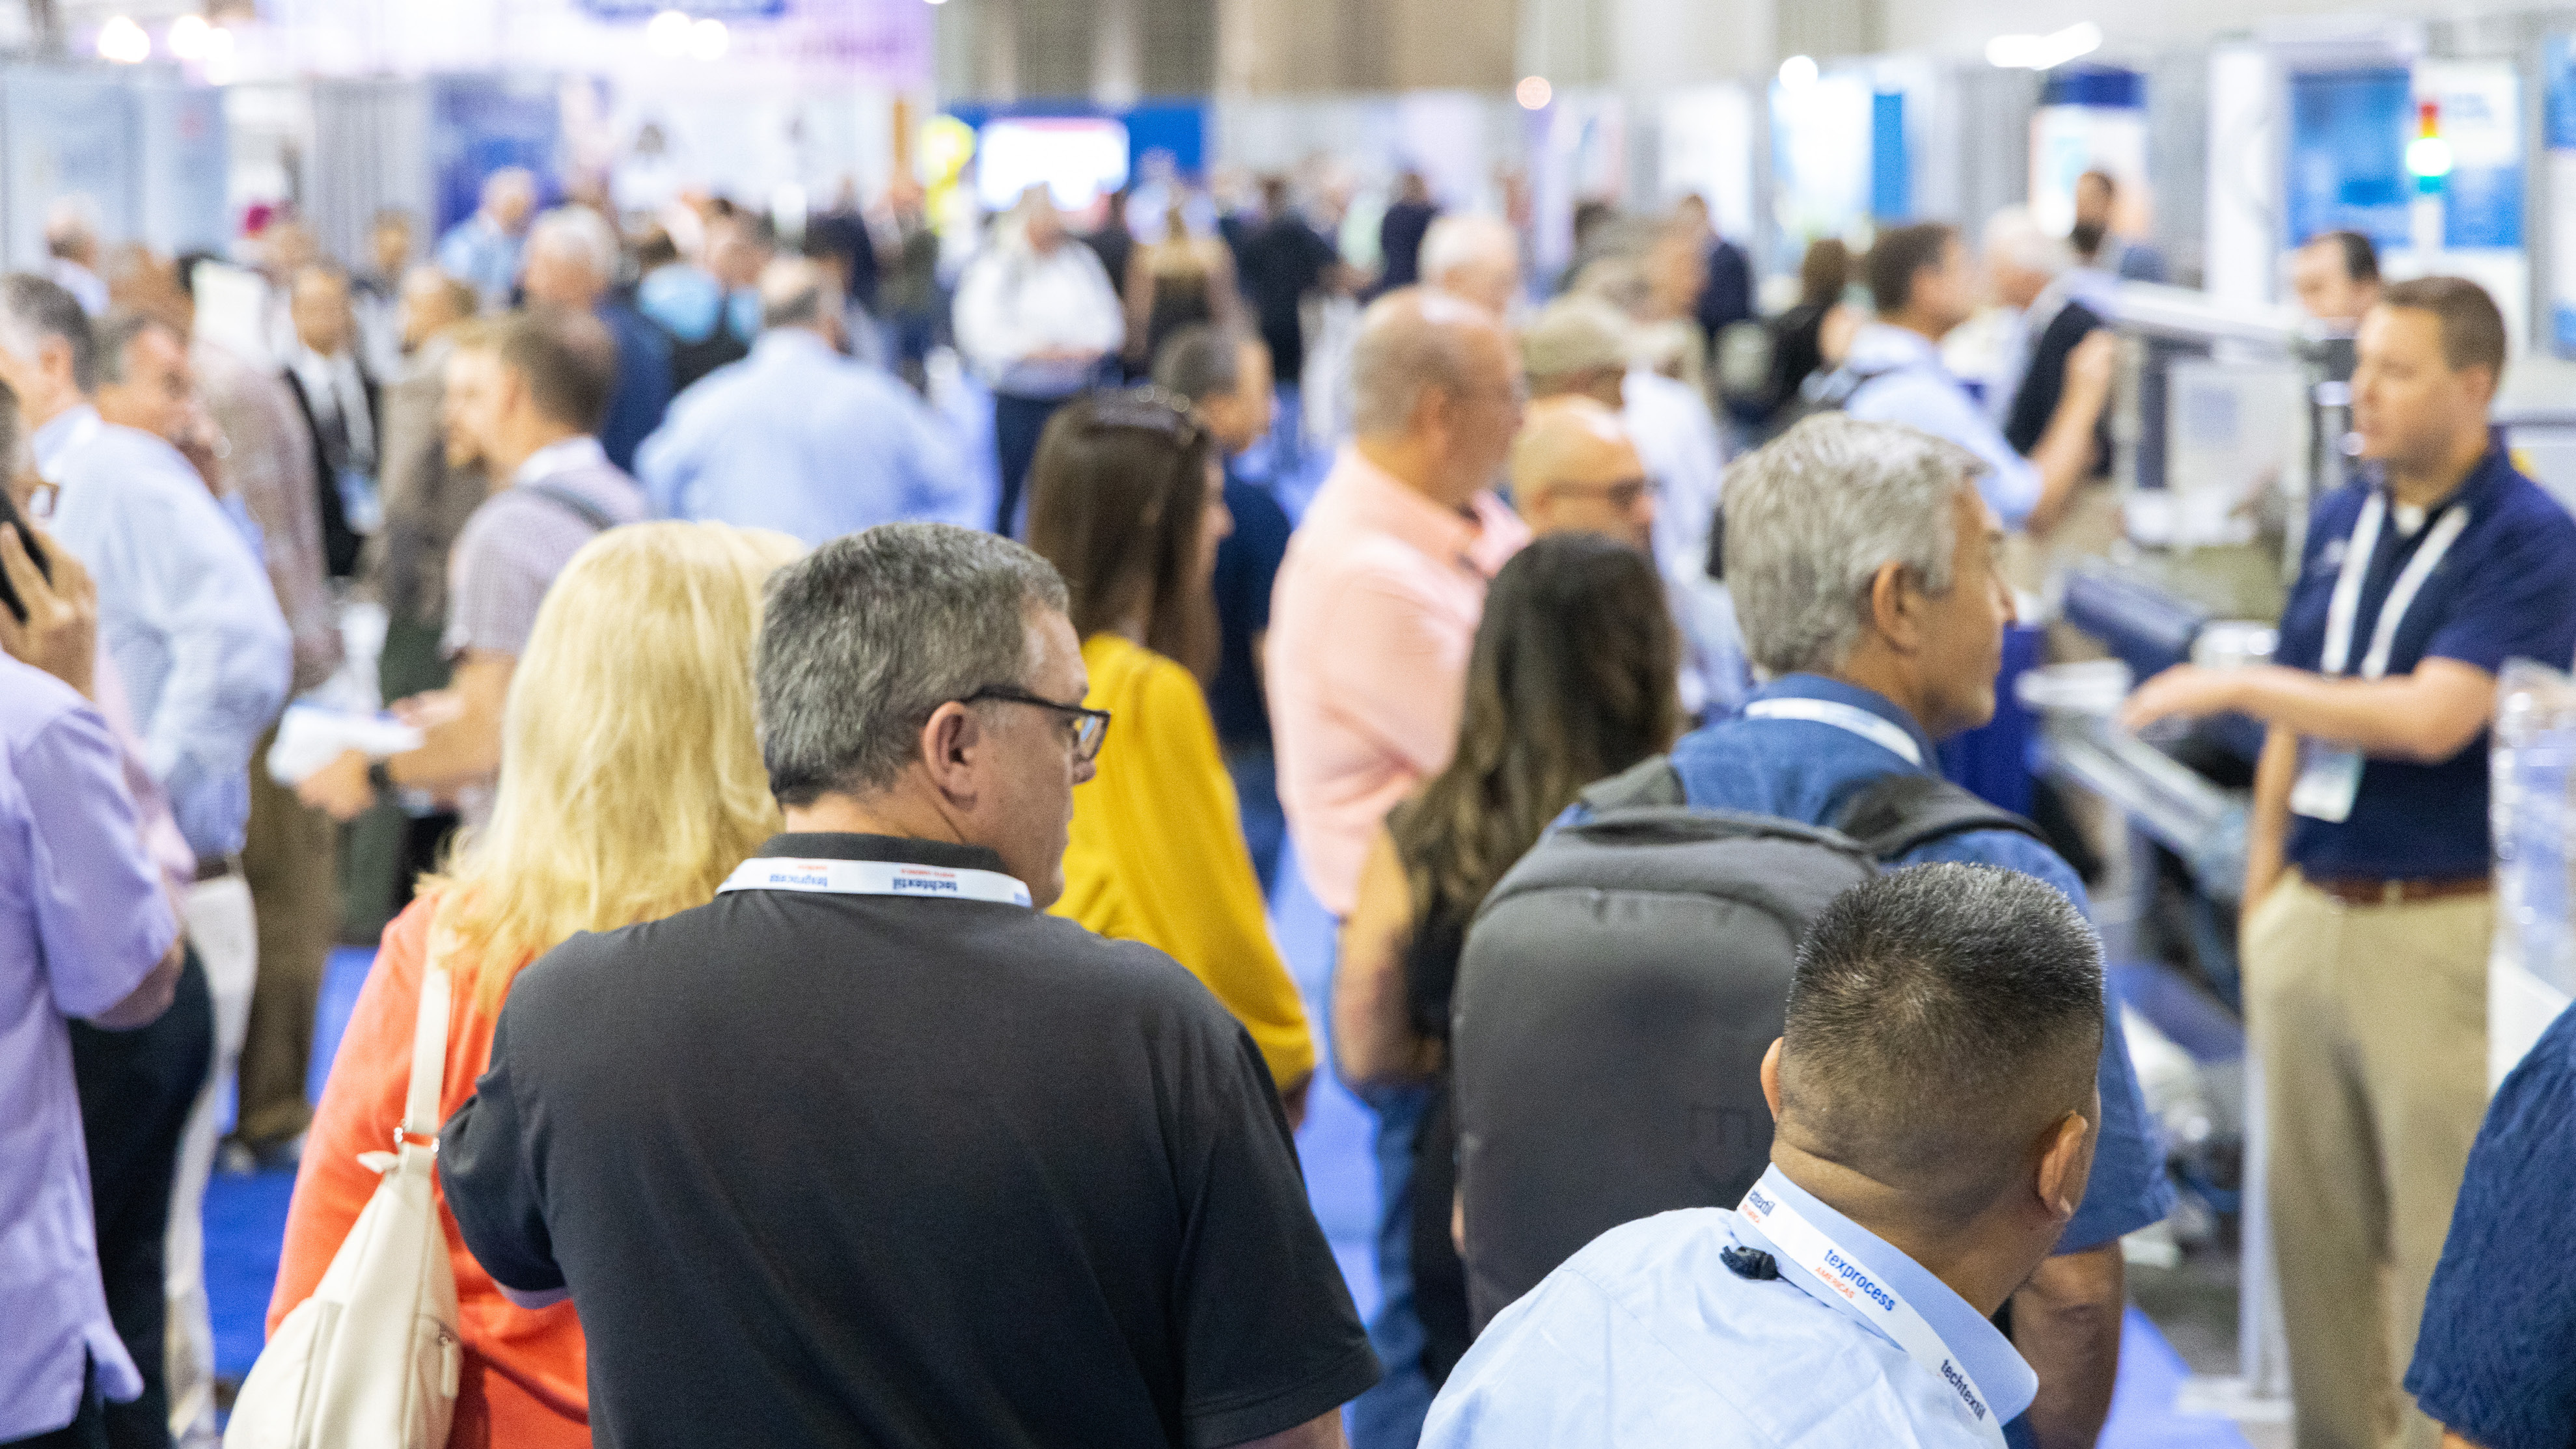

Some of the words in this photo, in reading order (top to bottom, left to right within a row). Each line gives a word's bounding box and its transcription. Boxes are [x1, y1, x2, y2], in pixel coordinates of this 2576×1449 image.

[1815, 1266, 1855, 1299] AMERICAS
[1824, 1249, 1895, 1312] texprocess
[1941, 1359, 1986, 1422] techtextil
